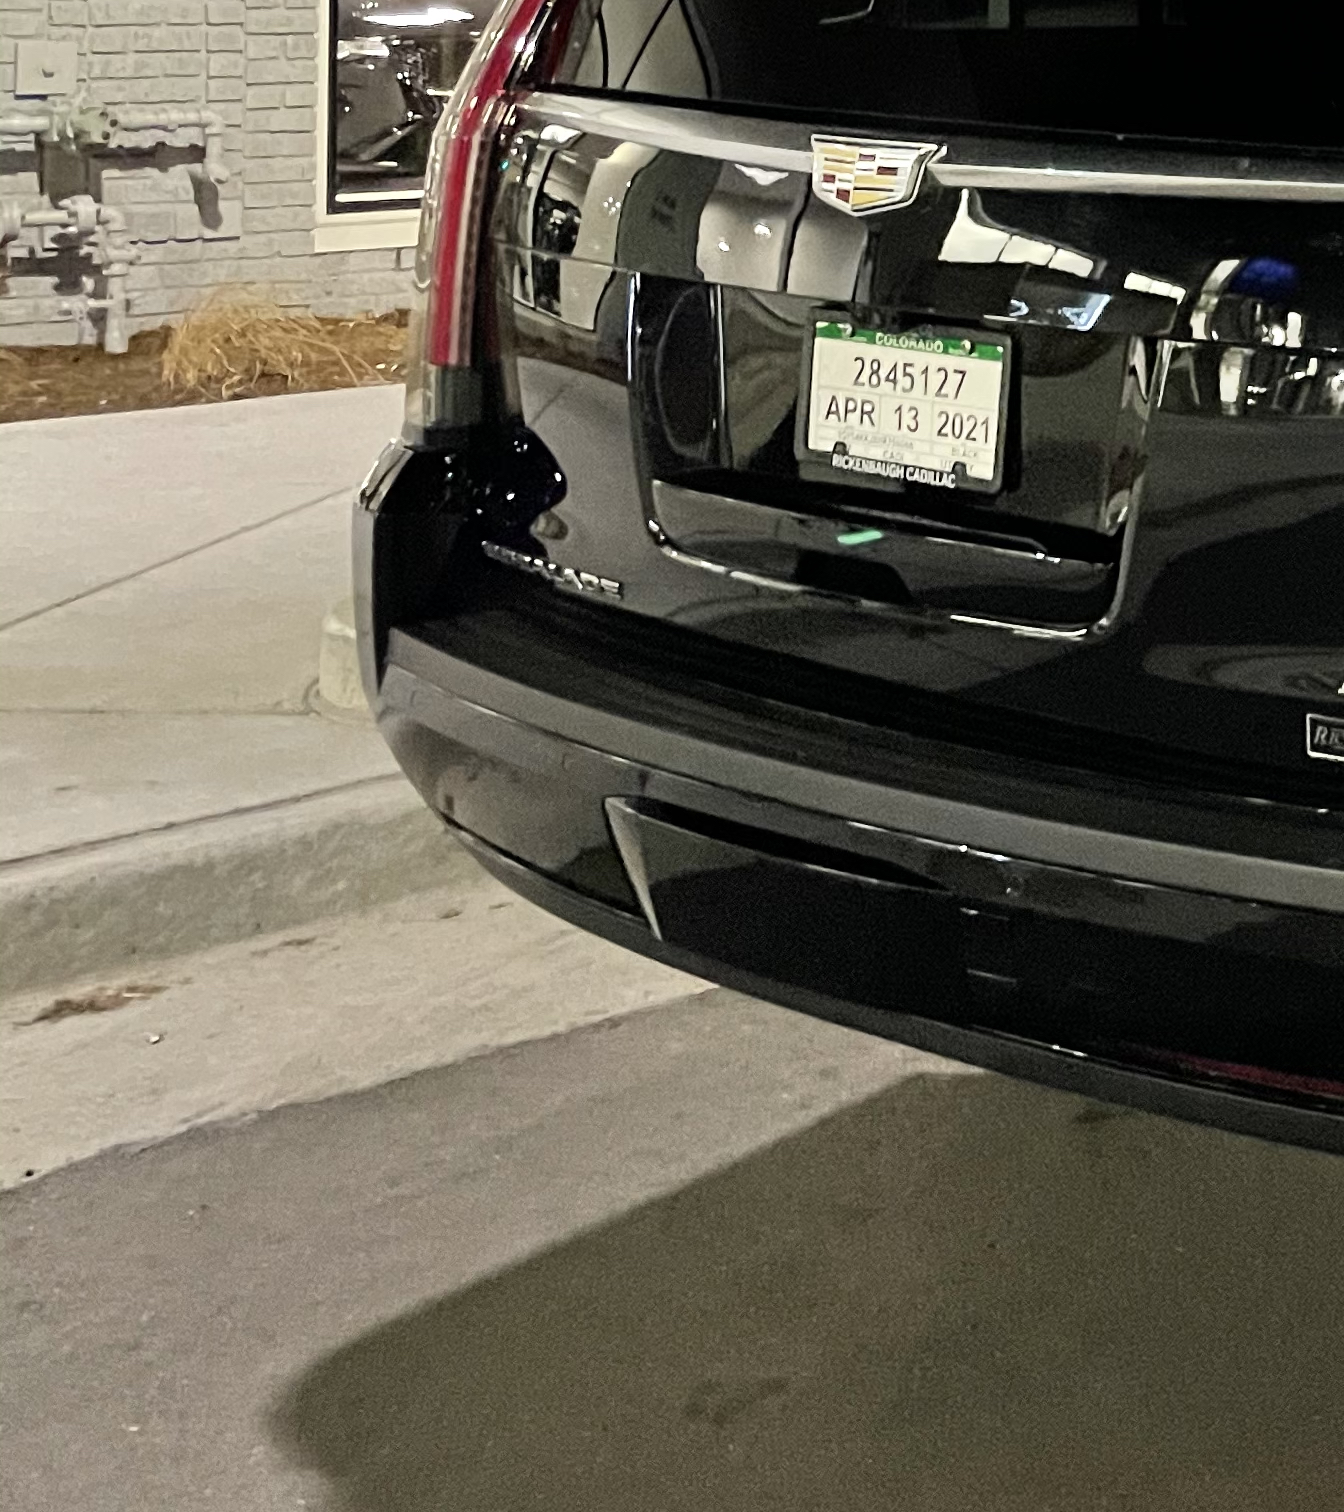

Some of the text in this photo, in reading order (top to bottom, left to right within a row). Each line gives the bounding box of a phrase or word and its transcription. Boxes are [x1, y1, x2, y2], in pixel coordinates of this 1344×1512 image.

[875, 332, 944, 353] COLORADO
[853, 356, 967, 400] 2845127
[825, 395, 875, 427] APR
[893, 404, 919, 433] 13
[936, 410, 990, 444] 2021
[831, 453, 905, 480] RICKENBAUGH
[905, 466, 956, 489] CADILLAC
